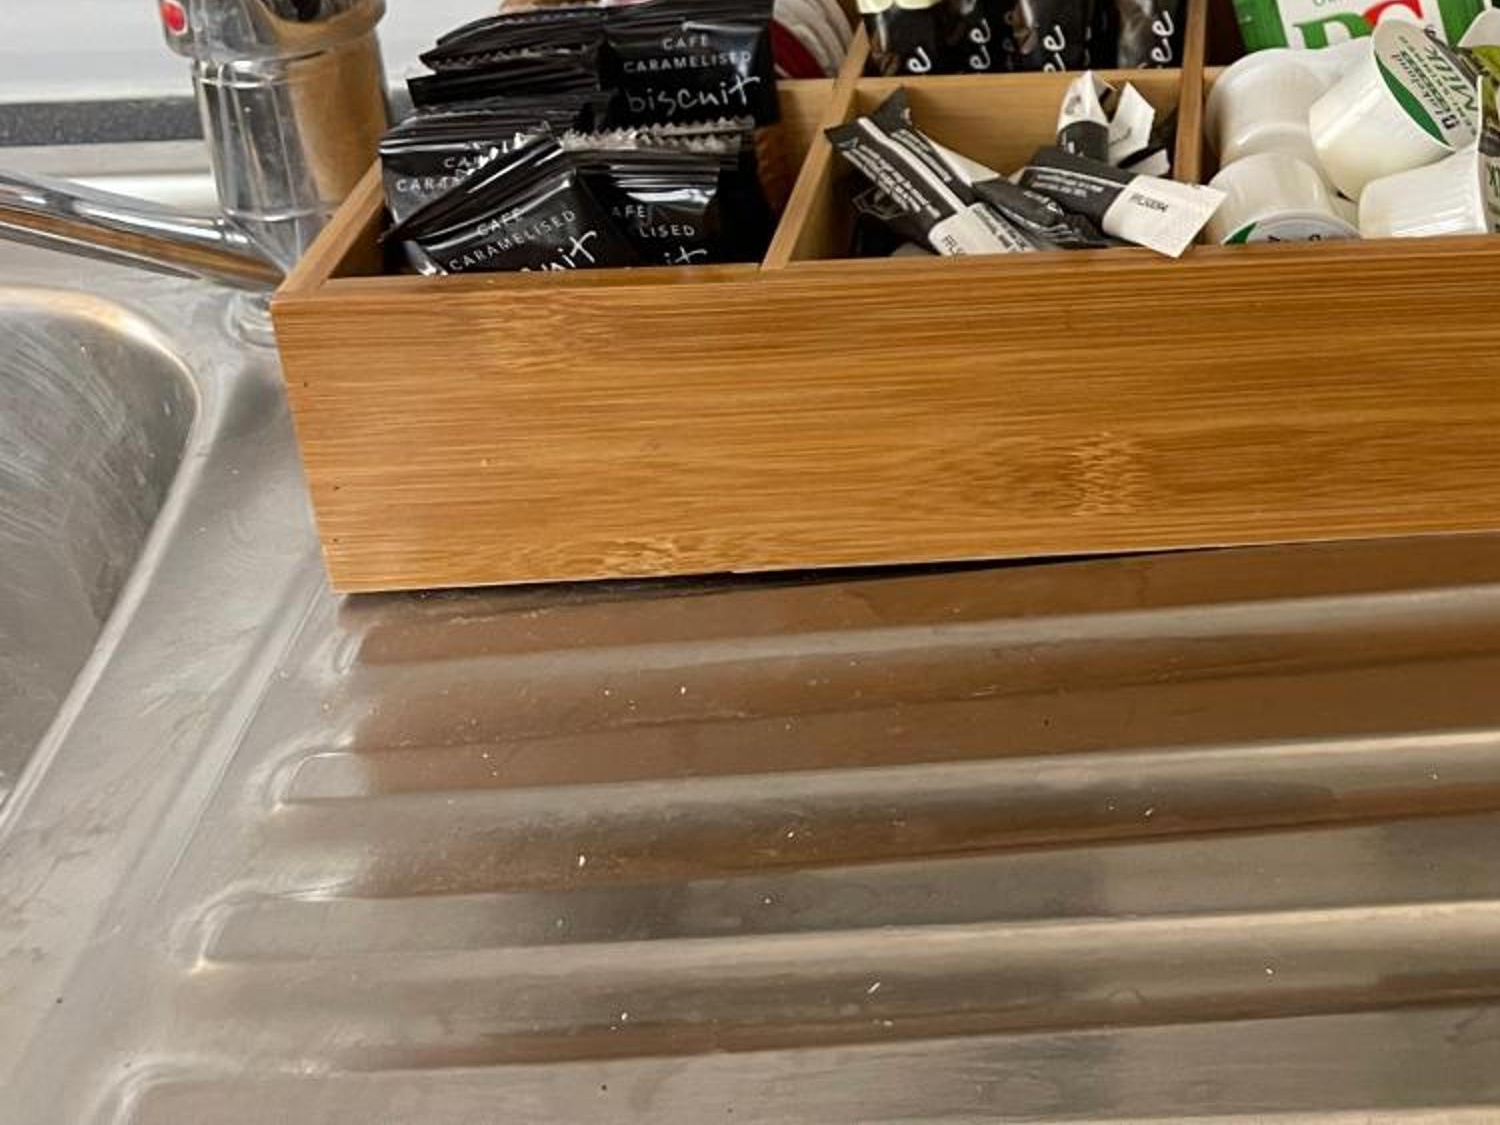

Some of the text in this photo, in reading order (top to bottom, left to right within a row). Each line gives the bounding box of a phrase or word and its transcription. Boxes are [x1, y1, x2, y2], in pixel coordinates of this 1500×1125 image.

[623, 51, 752, 74] CARAMELISED
[626, 74, 761, 117] biscuit
[449, 208, 577, 272] CARAMELISED
[639, 224, 695, 238] LISED
